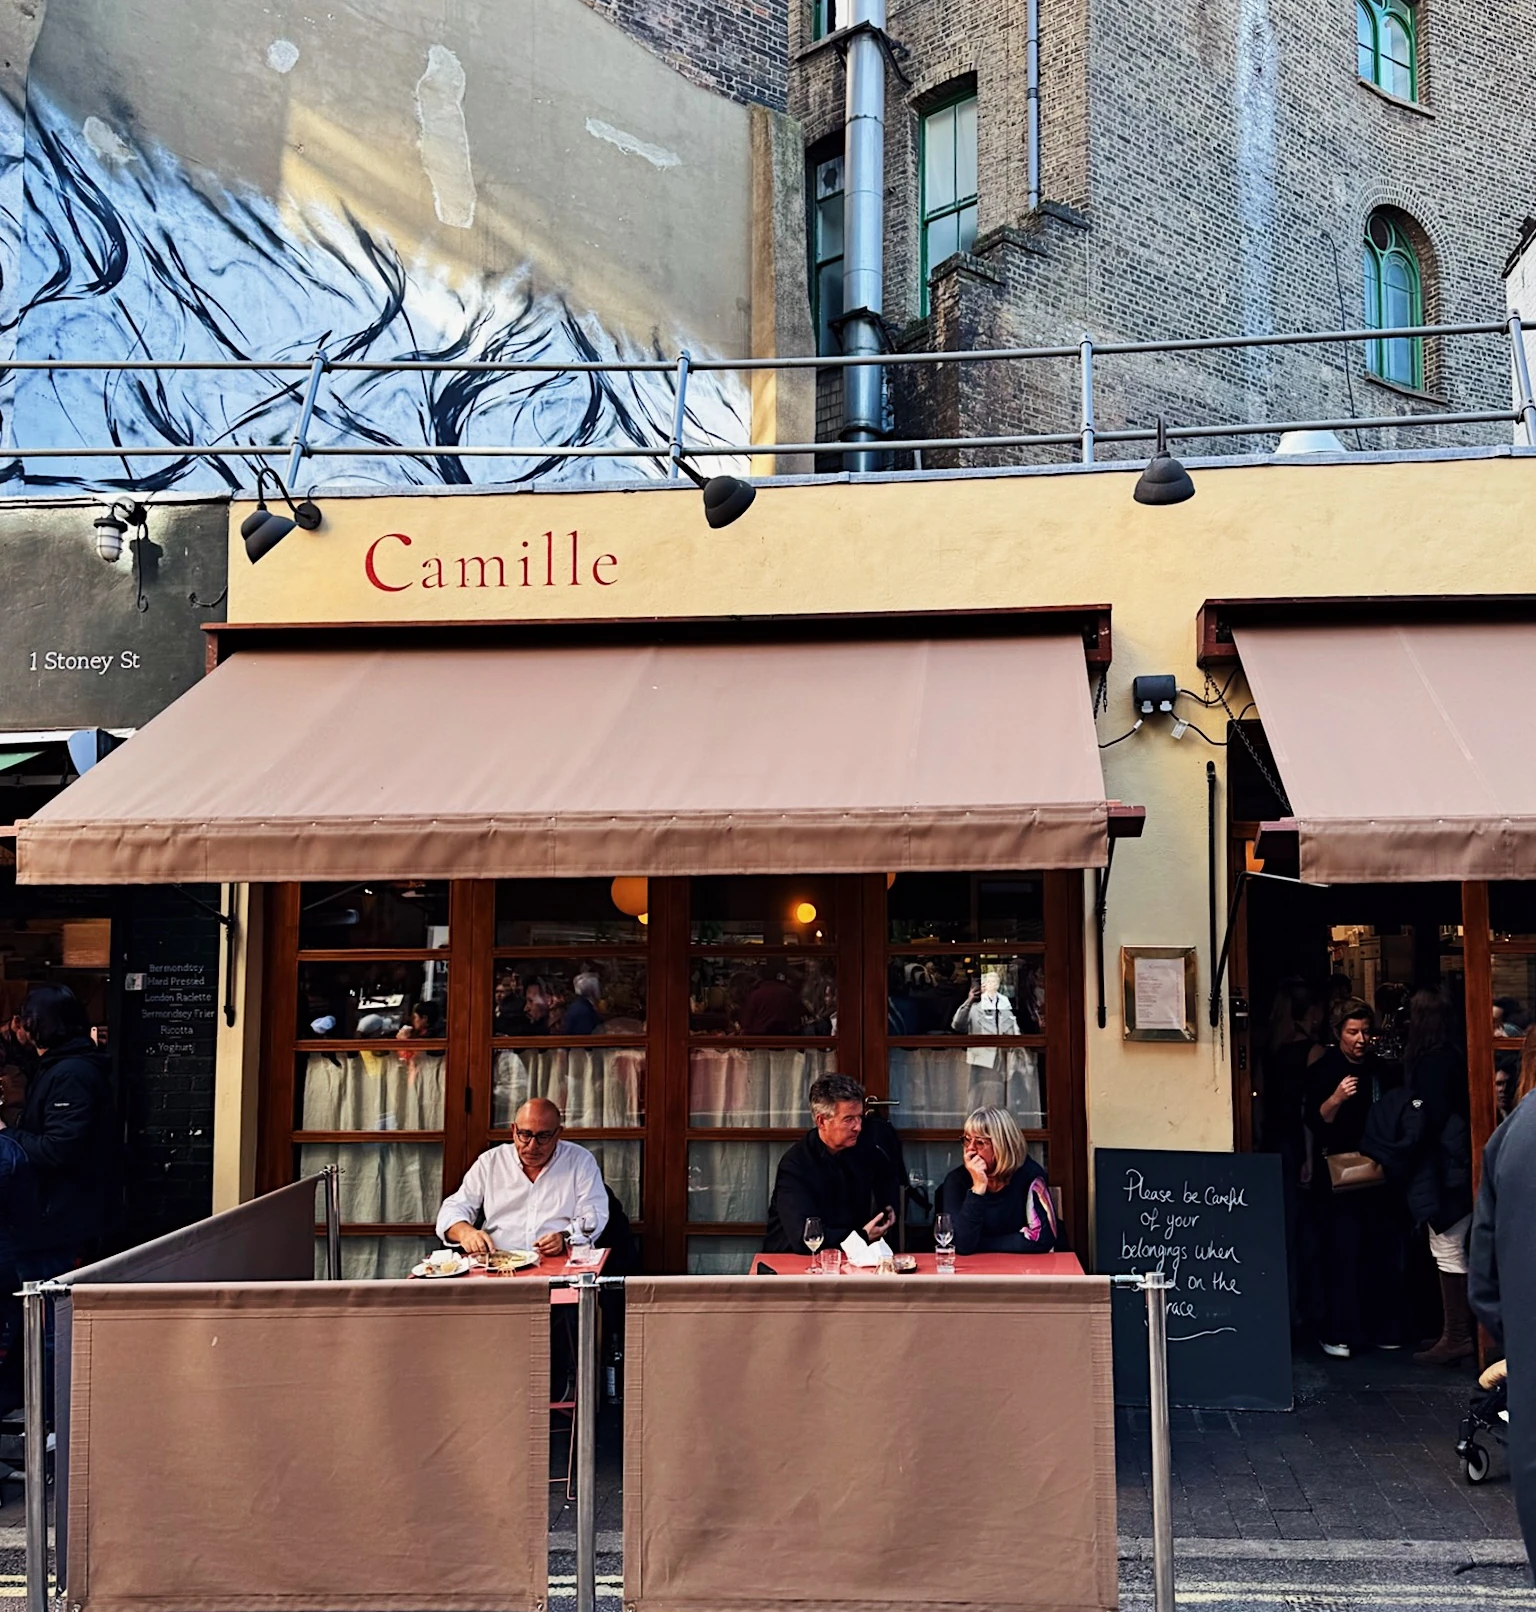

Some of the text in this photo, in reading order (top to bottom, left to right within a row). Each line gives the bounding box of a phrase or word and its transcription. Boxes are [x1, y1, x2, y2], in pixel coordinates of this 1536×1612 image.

[365, 530, 619, 592] Camille
[29, 651, 141, 675] 1 Stoney St
[170, 976, 205, 986] Pressed
[144, 991, 174, 1002] London
[160, 1024, 194, 1035] Ricotta
[1123, 1169, 1175, 1202] Please
[1183, 1180, 1201, 1204] be
[1140, 1207, 1200, 1240] of your
[1195, 1240, 1241, 1264] when
[1188, 1275, 1206, 1291] on
[1212, 1271, 1242, 1295] the
